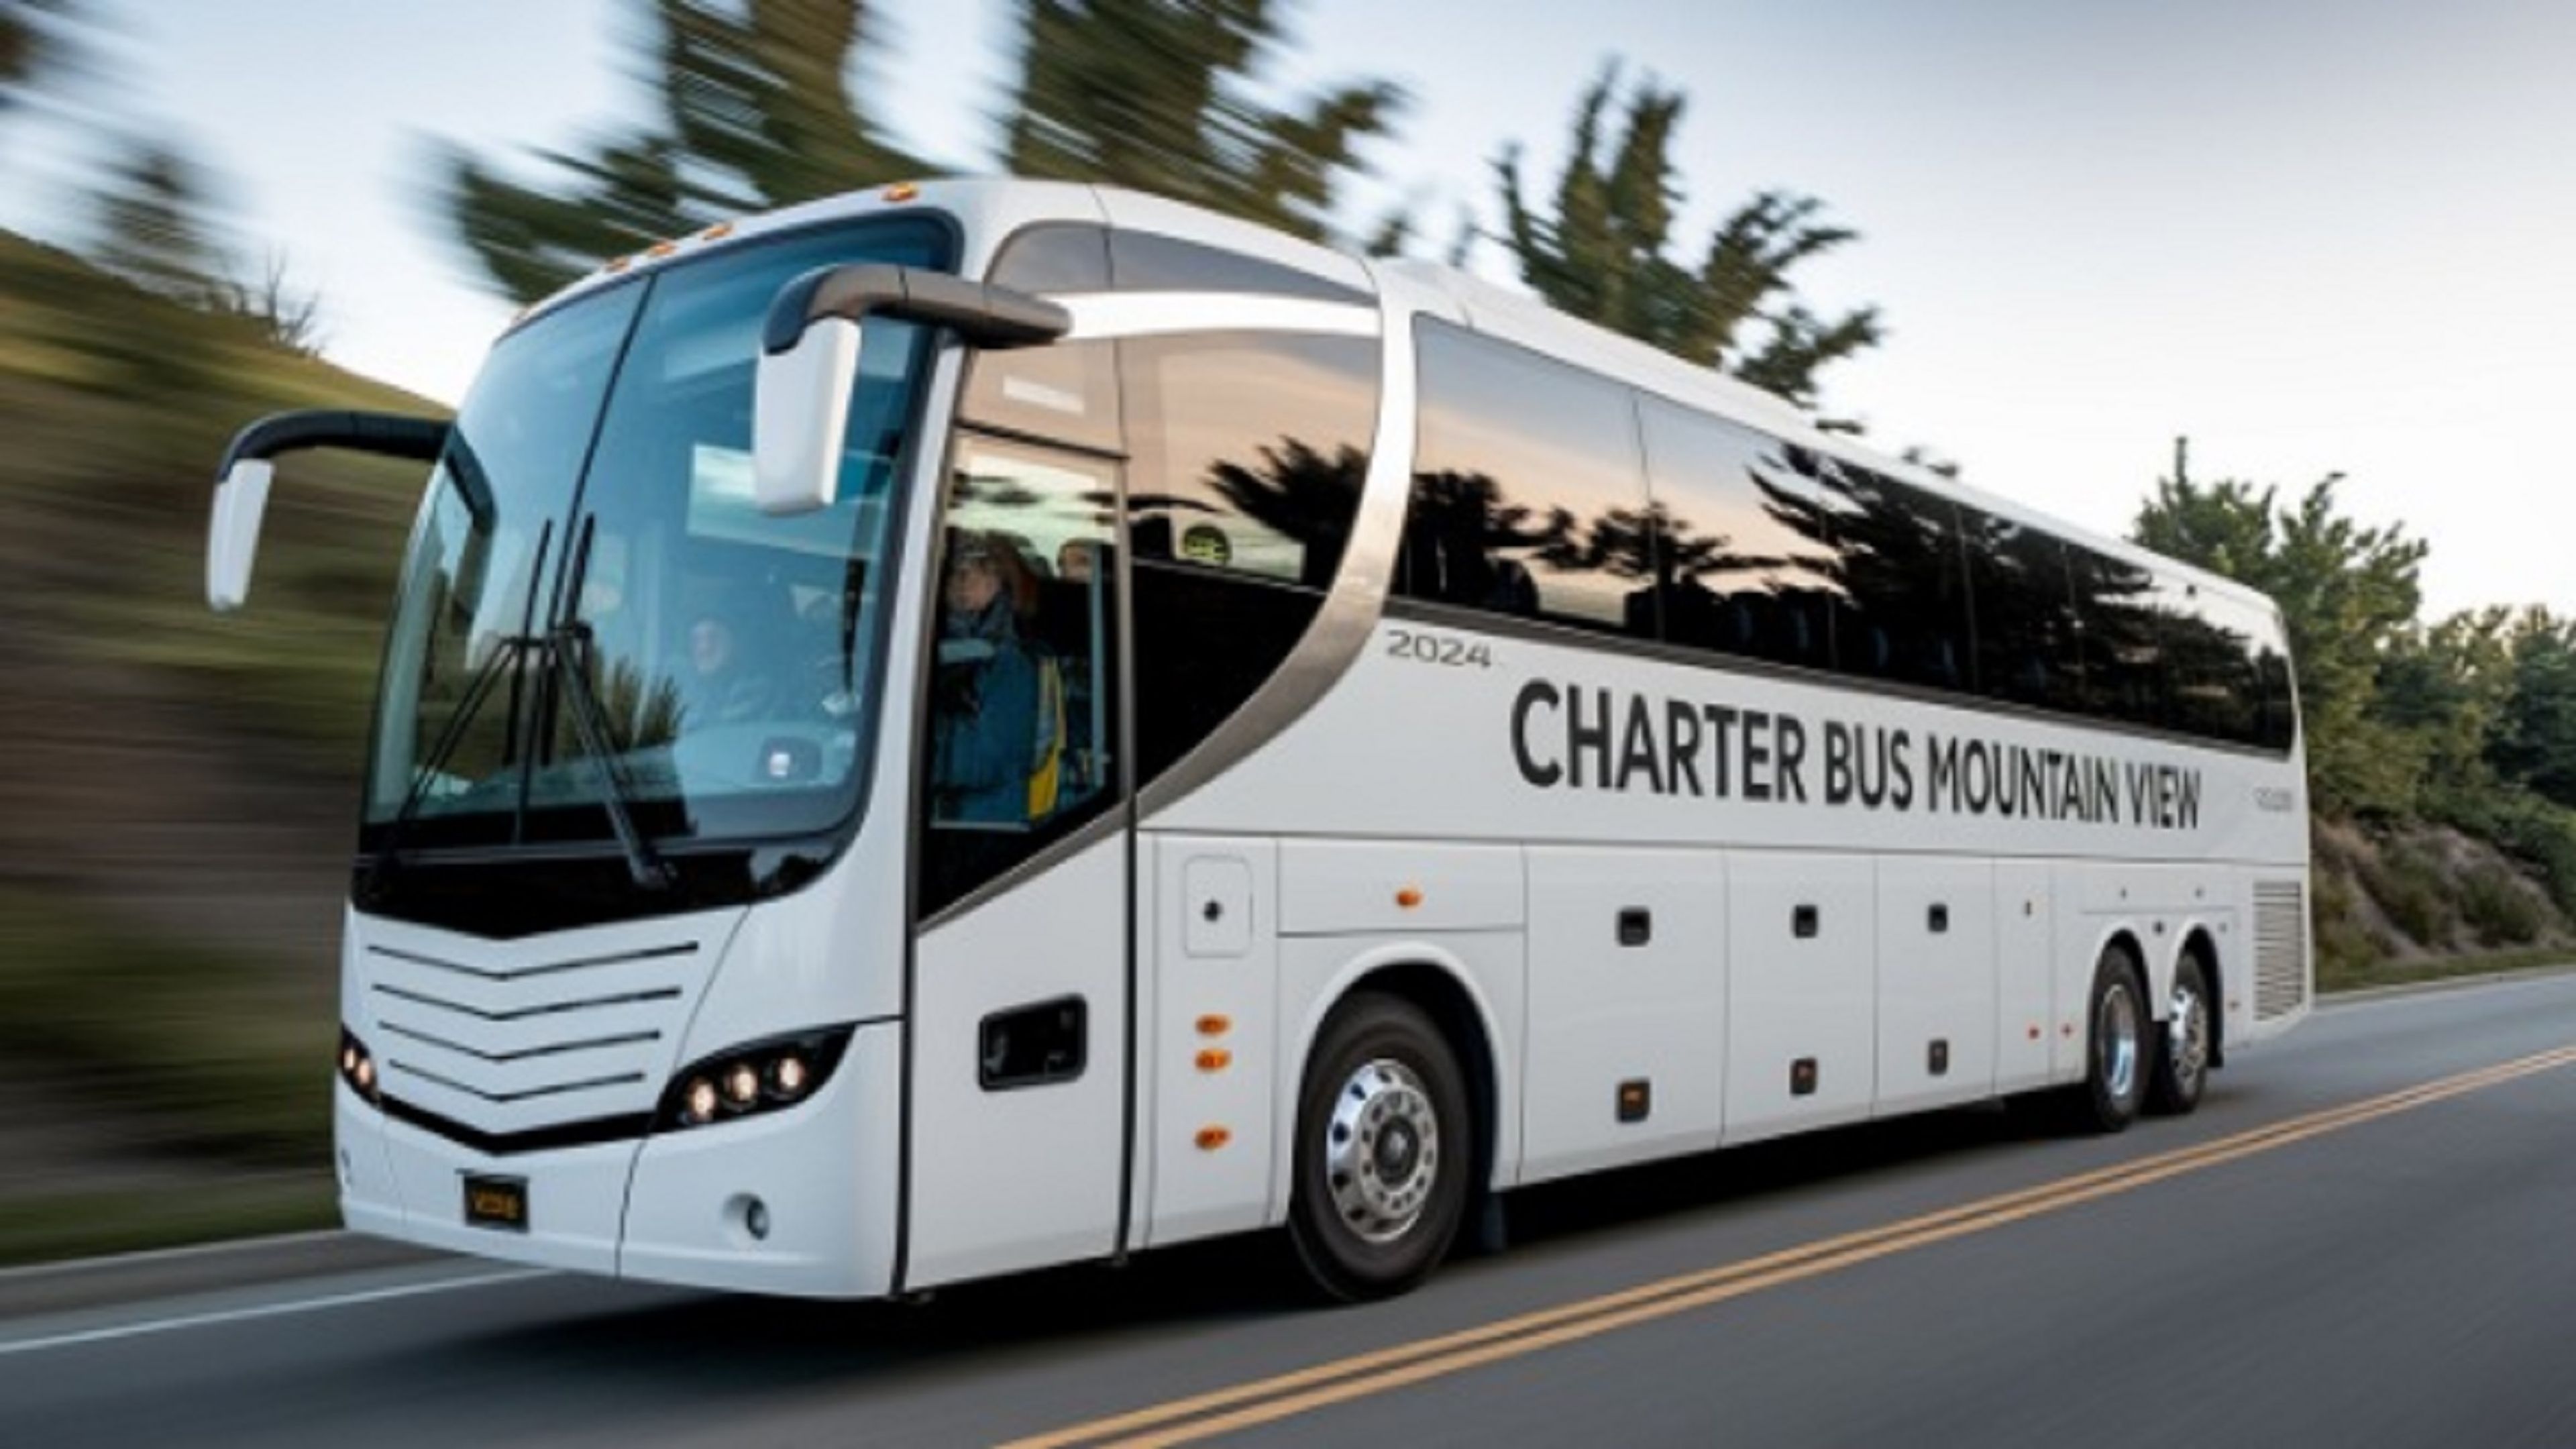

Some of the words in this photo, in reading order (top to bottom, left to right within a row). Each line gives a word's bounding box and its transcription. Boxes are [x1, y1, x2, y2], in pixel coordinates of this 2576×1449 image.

[1387, 630, 1492, 668] 2024
[1511, 677, 1808, 803] CHARTER
[1823, 720, 1913, 812] BUS
[1927, 733, 2118, 824] MOUNTAIN
[2127, 761, 2200, 829] VIEW
